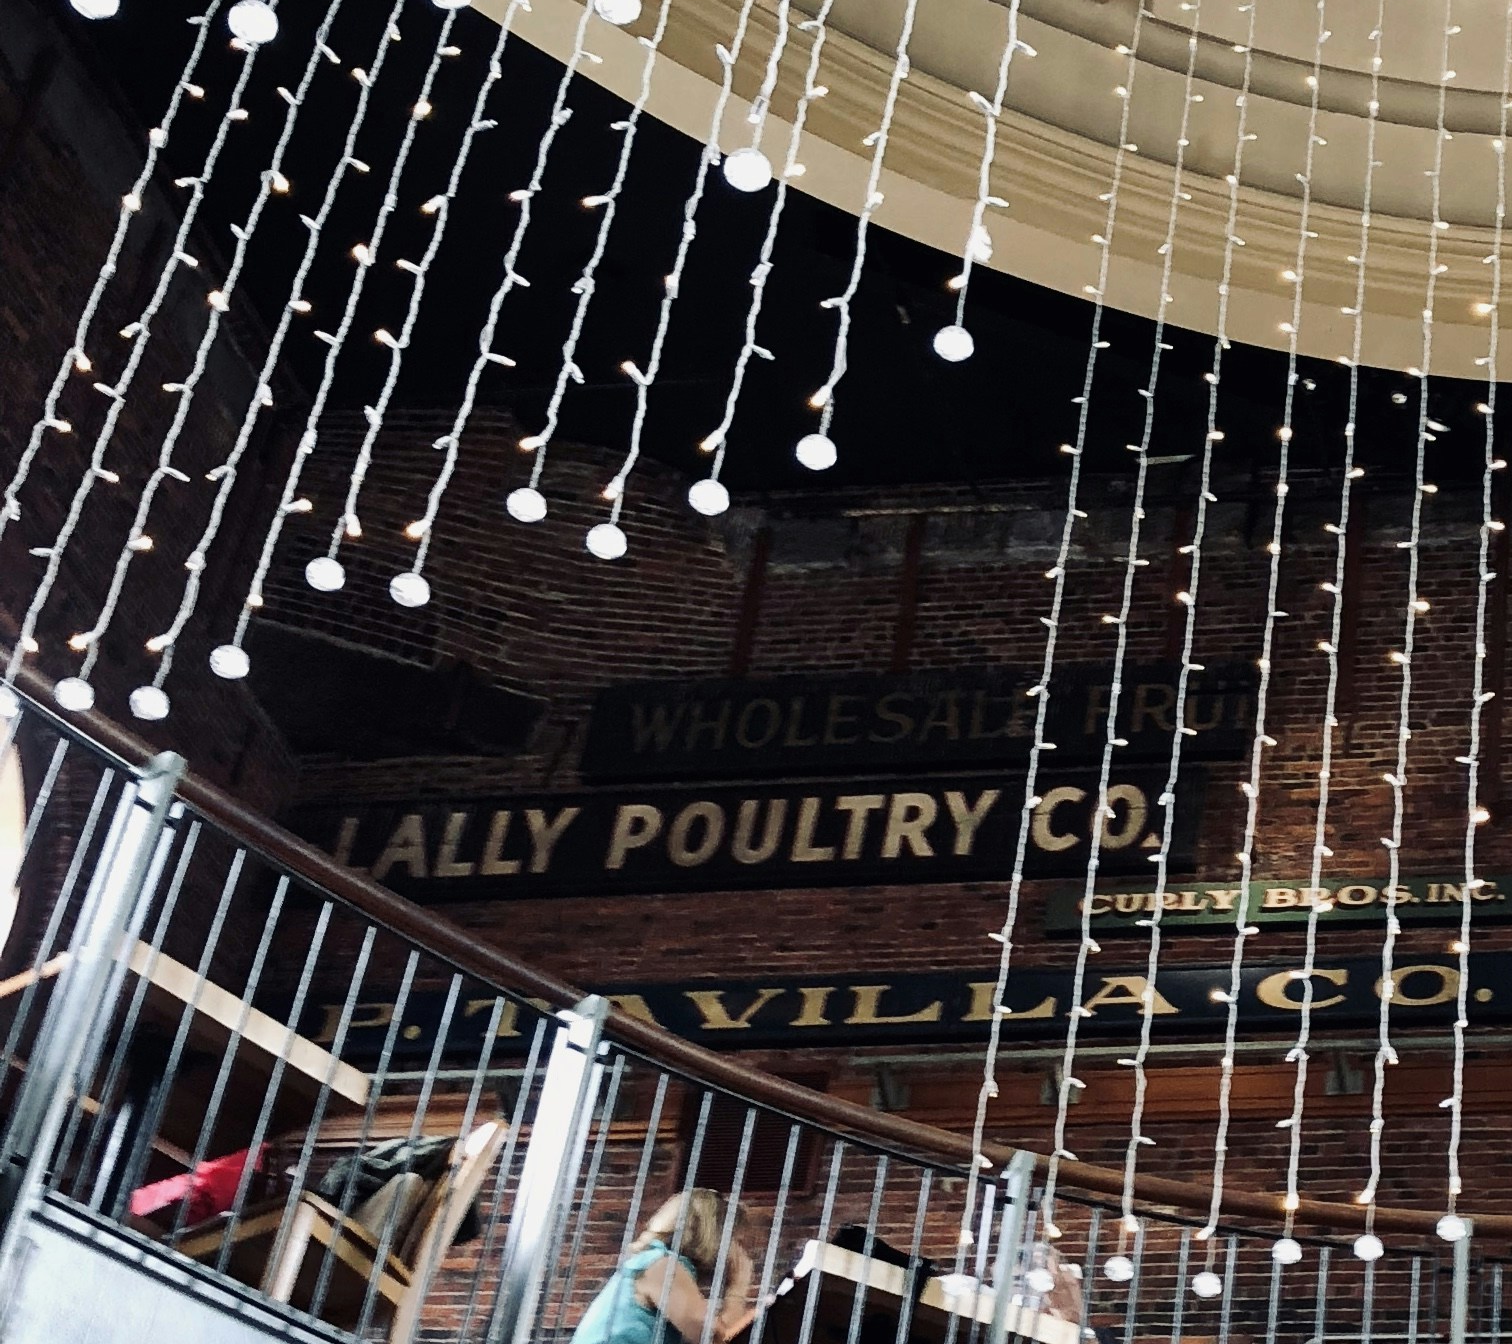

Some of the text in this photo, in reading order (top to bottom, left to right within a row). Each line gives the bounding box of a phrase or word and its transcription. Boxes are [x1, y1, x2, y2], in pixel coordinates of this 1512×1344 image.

[629, 686, 1037, 752] WHOLESALE
[338, 782, 1163, 880] LALLY POULTRY CO.
[1254, 965, 1493, 1012] CO.
